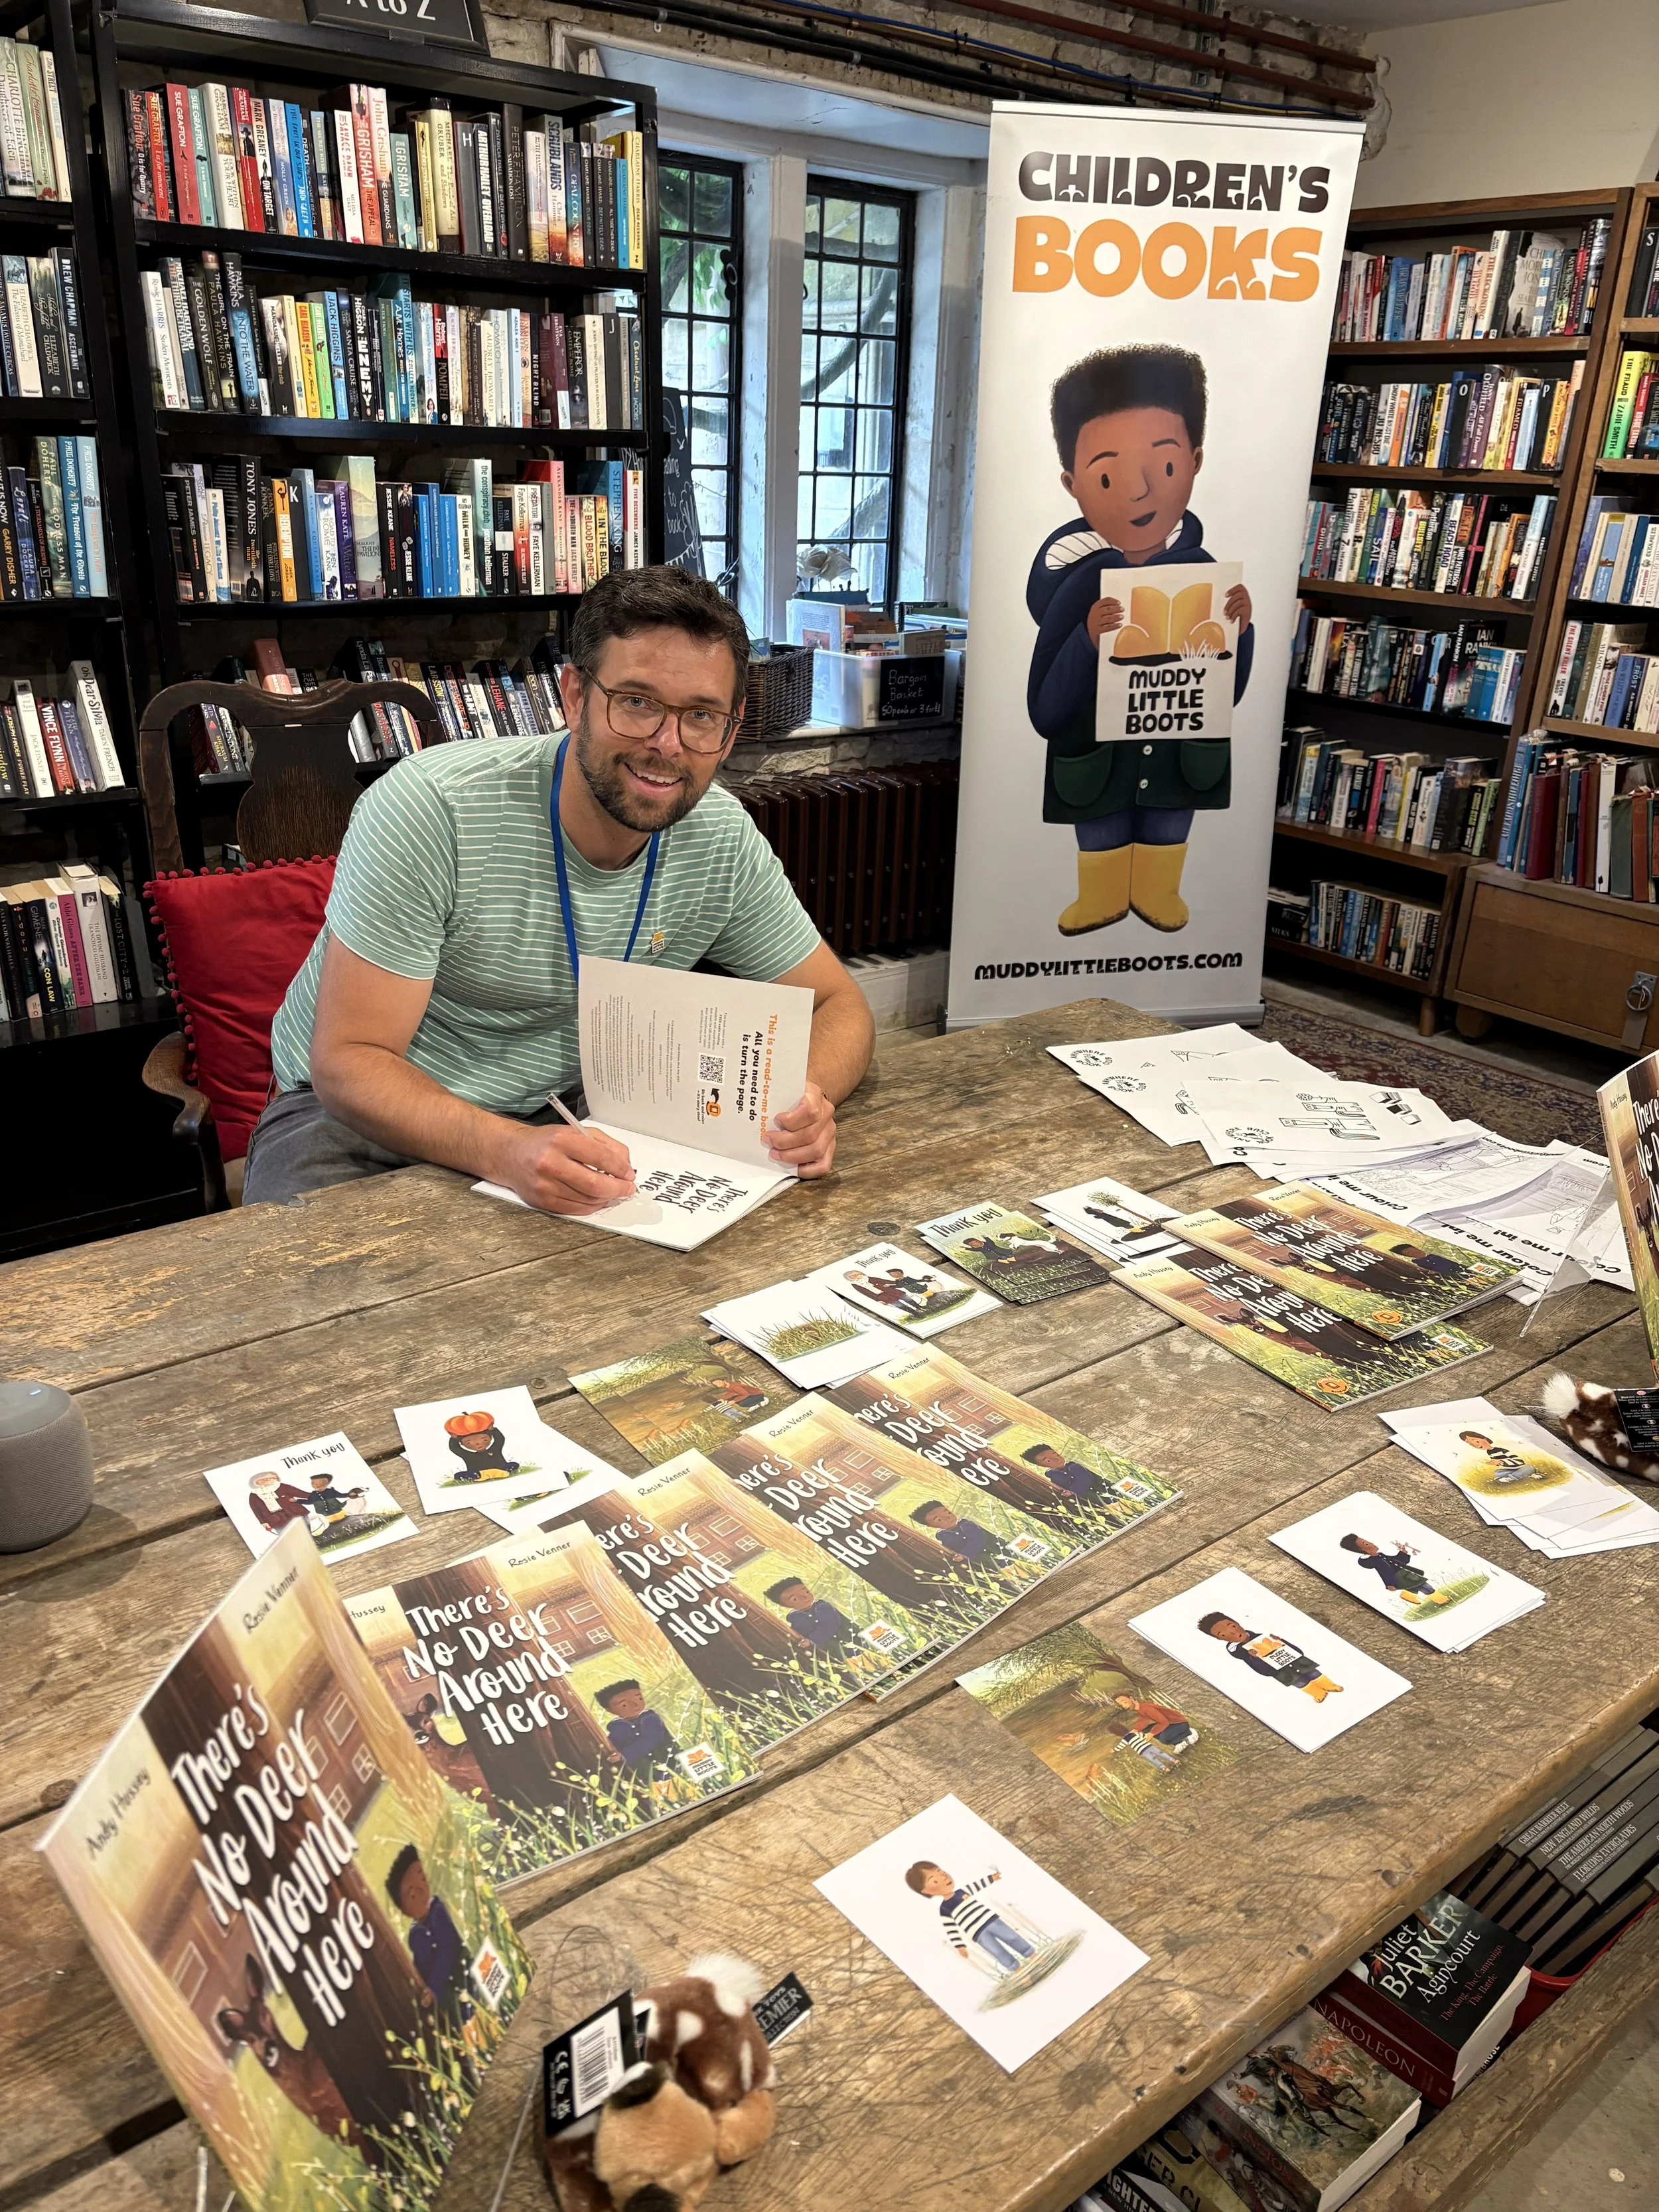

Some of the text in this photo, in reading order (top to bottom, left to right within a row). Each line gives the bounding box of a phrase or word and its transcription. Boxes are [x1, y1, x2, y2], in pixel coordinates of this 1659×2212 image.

[175, 104, 186, 147] GRAFTON
[252, 102, 267, 157] MARK GREANEY
[357, 129, 375, 188] GRISHAM
[548, 121, 561, 190] SCRUBLANDS
[262, 181, 274, 216] ON TARGET
[1019, 151, 1330, 213] CHILDREN'S
[482, 199, 494, 243] OVERLOAD
[1013, 215, 1323, 302] BOOKS
[61, 259, 78, 327] DREW CHAPMAN
[194, 288, 213, 364] GOLDEN WOLF
[328, 295, 341, 362] JACK HIGGINS
[238, 317, 248, 339] INTO
[244, 360, 255, 392] WATER
[438, 362, 449, 400] POMPEII
[1622, 373, 1632, 396] FRAUD
[1609, 425, 1622, 450] SMITH
[184, 480, 196, 536] PETER JAMES
[246, 462, 257, 535] TONY JONES
[613, 471, 622, 553] STEPHEN KING
[666, 512, 684, 534] book
[2, 528, 16, 584] GARRY DISHER
[586, 543, 595, 577] BROTHER
[1370, 538, 1382, 561] SAIL
[1453, 636, 1463, 662] RANKIN
[1477, 629, 1494, 642] IAN
[889, 670, 926, 686] Bargain
[891, 688, 923, 701] Basket
[1129, 668, 1206, 689] MUDDY
[920, 704, 924, 713] 3
[1127, 688, 1204, 713] LITTLE
[42, 705, 65, 763] VINCE FLYNN
[1125, 712, 1204, 735] BOOTS
[43, 968, 56, 1002] CON LAW
[974, 952, 1243, 980] MUDDYLITTLEBOOTS.COM
[768, 1015, 777, 1035] This
[739, 1069, 748, 1085] the
[761, 1058, 771, 1113] read-to-me
[749, 1108, 757, 1121] do
[750, 1096, 757, 1106] to
[1609, 1098, 1620, 1110] Andy
[1636, 1136, 1652, 1179] No
[639, 1171, 675, 1191] Here
[652, 1171, 707, 1205] Around
[679, 1176, 733, 1214] No Deer
[1269, 1194, 1283, 1203] Rosie
[1339, 1181, 1408, 1211] Colour me
[707, 1188, 748, 1213] There's
[1233, 1208, 1293, 1231] There's
[928, 1208, 1003, 1237] Thank you
[1184, 1216, 1220, 1229] Andy Hussey
[1256, 1214, 1331, 1248] No Deer
[1494, 1229, 1550, 1252] me in!
[1289, 1231, 1364, 1262] Around
[1335, 1248, 1384, 1273] Here
[1441, 1224, 1553, 1276] Colour me in!
[1206, 1284, 1241, 1302] No
[1287, 1307, 1344, 1333] Here
[280, 1442, 346, 1469] Thank you
[638, 1466, 691, 1498] Rosie Venner
[773, 1457, 842, 1511] Deer
[508, 1540, 571, 1568] Rosie Venner
[624, 1520, 700, 1580] Deer
[828, 1516, 899, 1570] Here
[405, 1584, 509, 1637] There's
[668, 1595, 747, 1649] Here
[402, 1602, 547, 1679] No Deer
[437, 1634, 574, 1718] Around
[482, 1690, 568, 1747] Here
[172, 1682, 269, 1824] There's
[695, 1761, 716, 1773] LITTLE
[697, 1766, 718, 1777] BOOTS
[192, 1709, 319, 1925] No Deer
[1518, 1801, 1569, 1844] GREAT BARRIER REEF
[1540, 1803, 1600, 1855] NEW ENGLAND WILDS
[1558, 1799, 1634, 1866] THE AMERICAN NORTH WOODS
[86, 1818, 119, 1860] Andy
[1573, 1824, 1636, 1880] FLORIDA'S EVERGLADES
[242, 1781, 360, 1994] Around
[303, 1897, 375, 2028] Here
[1372, 1924, 1417, 1972] Juliet
[1379, 1903, 1469, 1999] BARKER
[1417, 1929, 1480, 2003] Agincourt
[1440, 2004, 1454, 2021] The
[1465, 1976, 1478, 1991] The
[1468, 1972, 1498, 2006] The Battle
[1314, 1998, 1415, 2077] NAPOLEON
